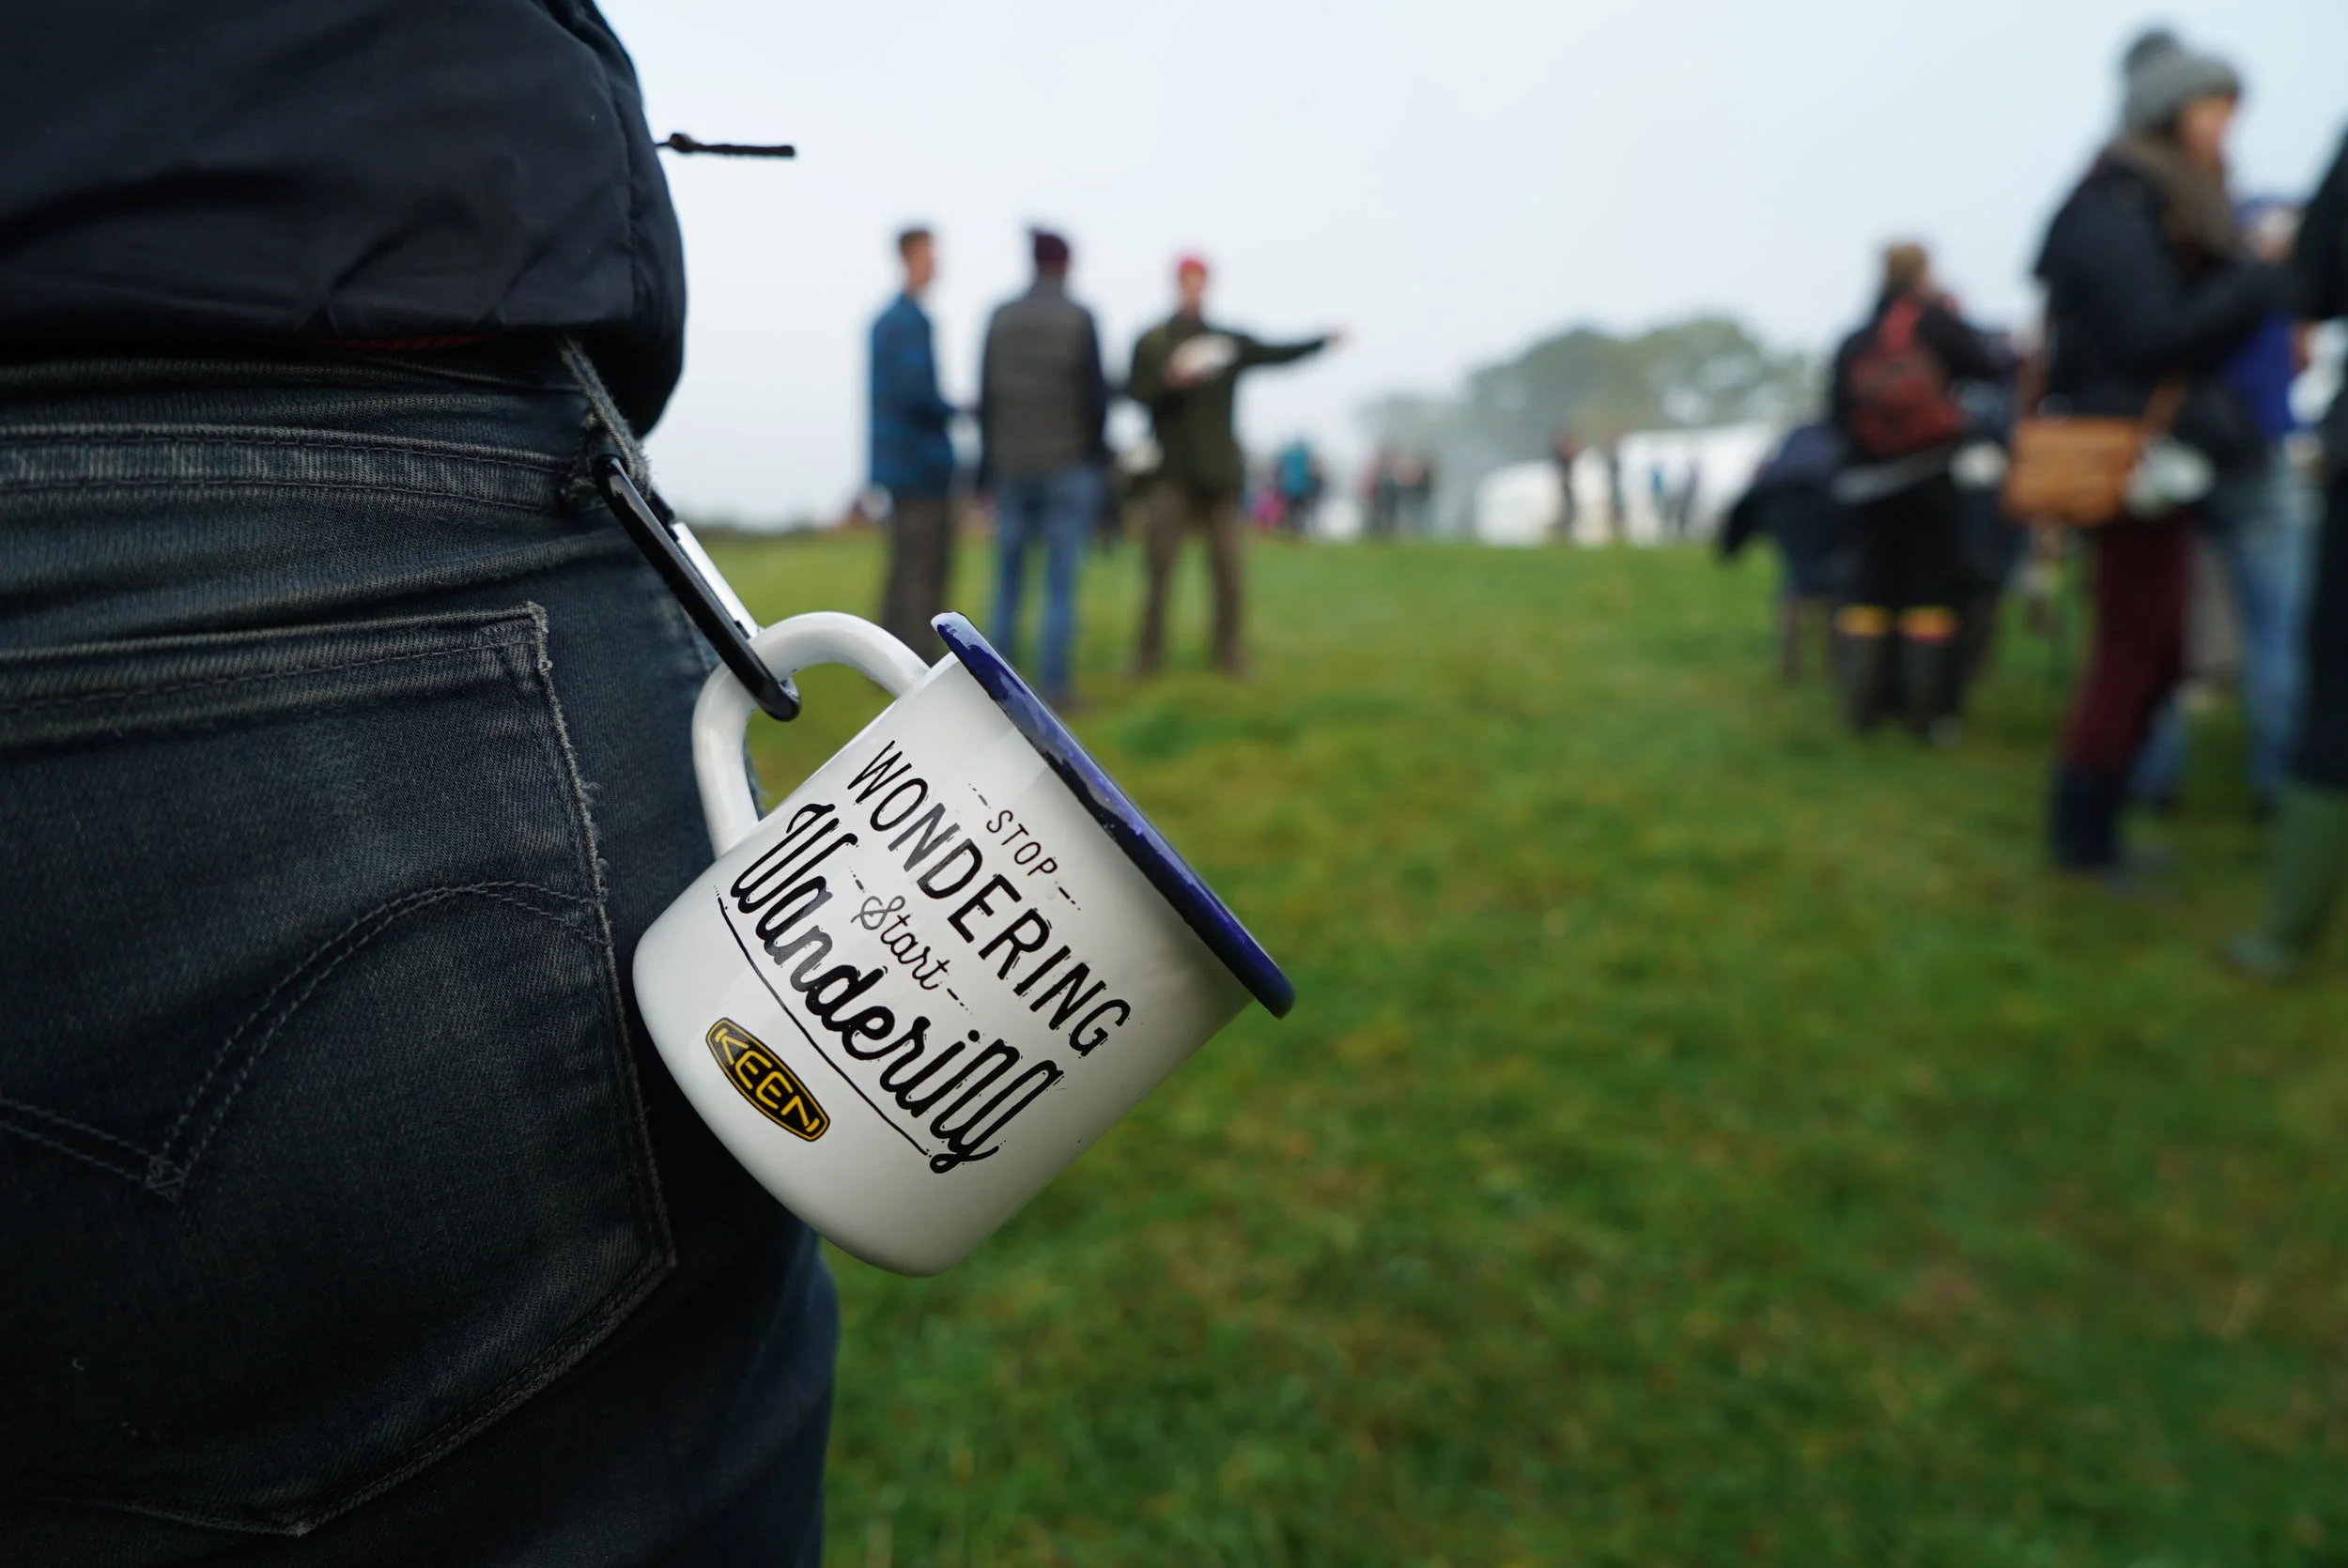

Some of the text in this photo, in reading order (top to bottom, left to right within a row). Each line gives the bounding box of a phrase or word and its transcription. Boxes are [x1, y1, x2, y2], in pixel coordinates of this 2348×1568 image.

[986, 809, 1058, 877] STOP
[847, 740, 1131, 1057] WONDERING
[851, 895, 950, 992] Start
[729, 803, 1064, 1174] Wandering
[714, 1027, 820, 1132] KEEN
